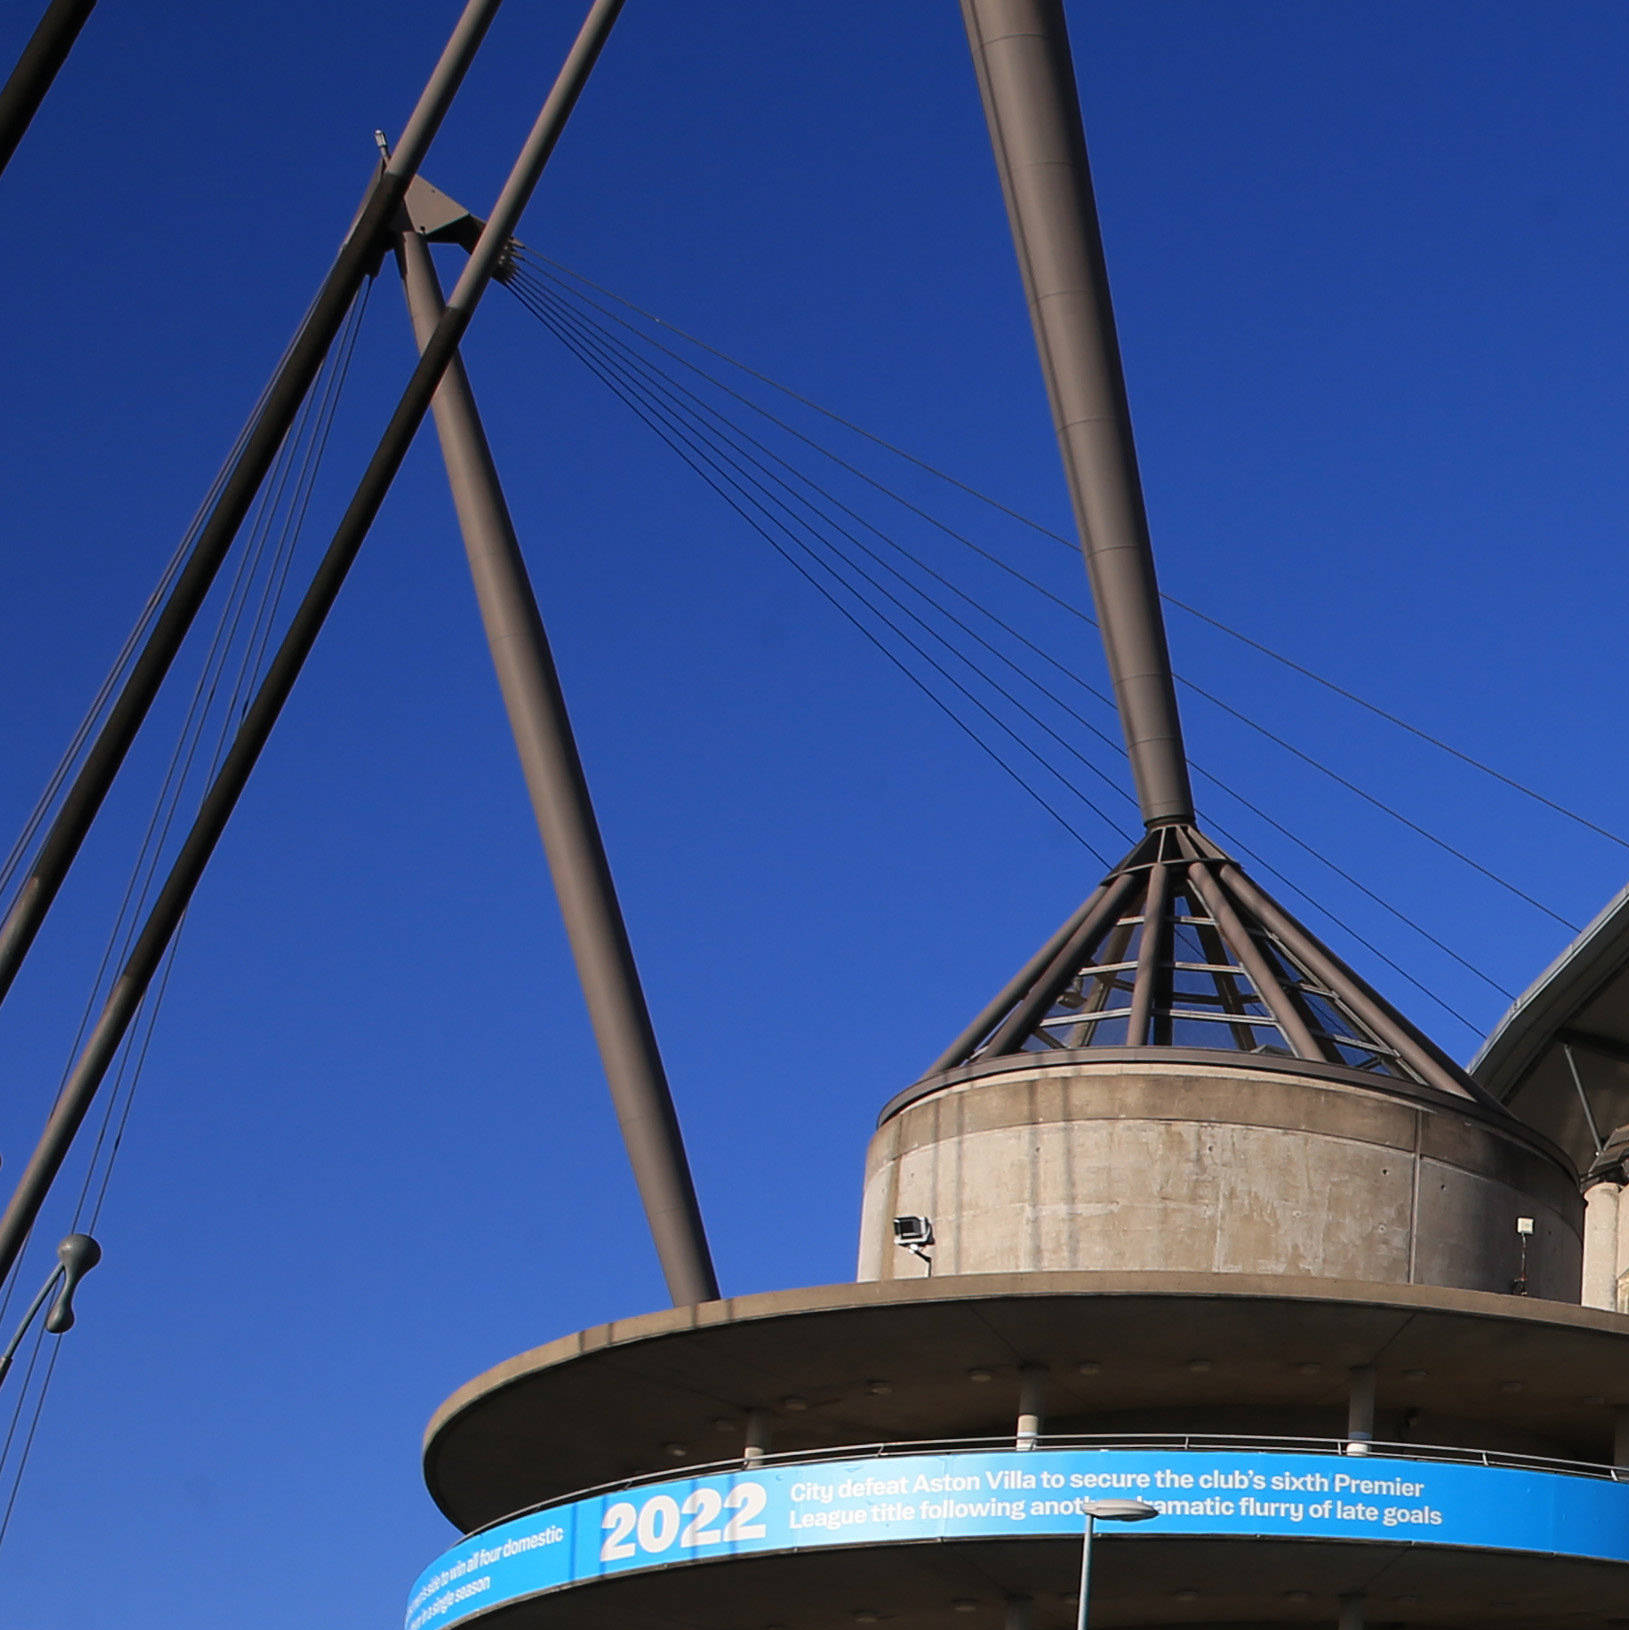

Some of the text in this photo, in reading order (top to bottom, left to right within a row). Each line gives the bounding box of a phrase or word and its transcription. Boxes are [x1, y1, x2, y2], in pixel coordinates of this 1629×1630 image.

[601, 1469, 1424, 1562] 2022 City Aston Villa secure the club's Premier
[789, 1496, 1443, 1531] League following flurry late goals
[479, 1546, 502, 1567] four
[503, 1525, 564, 1558] domestic
